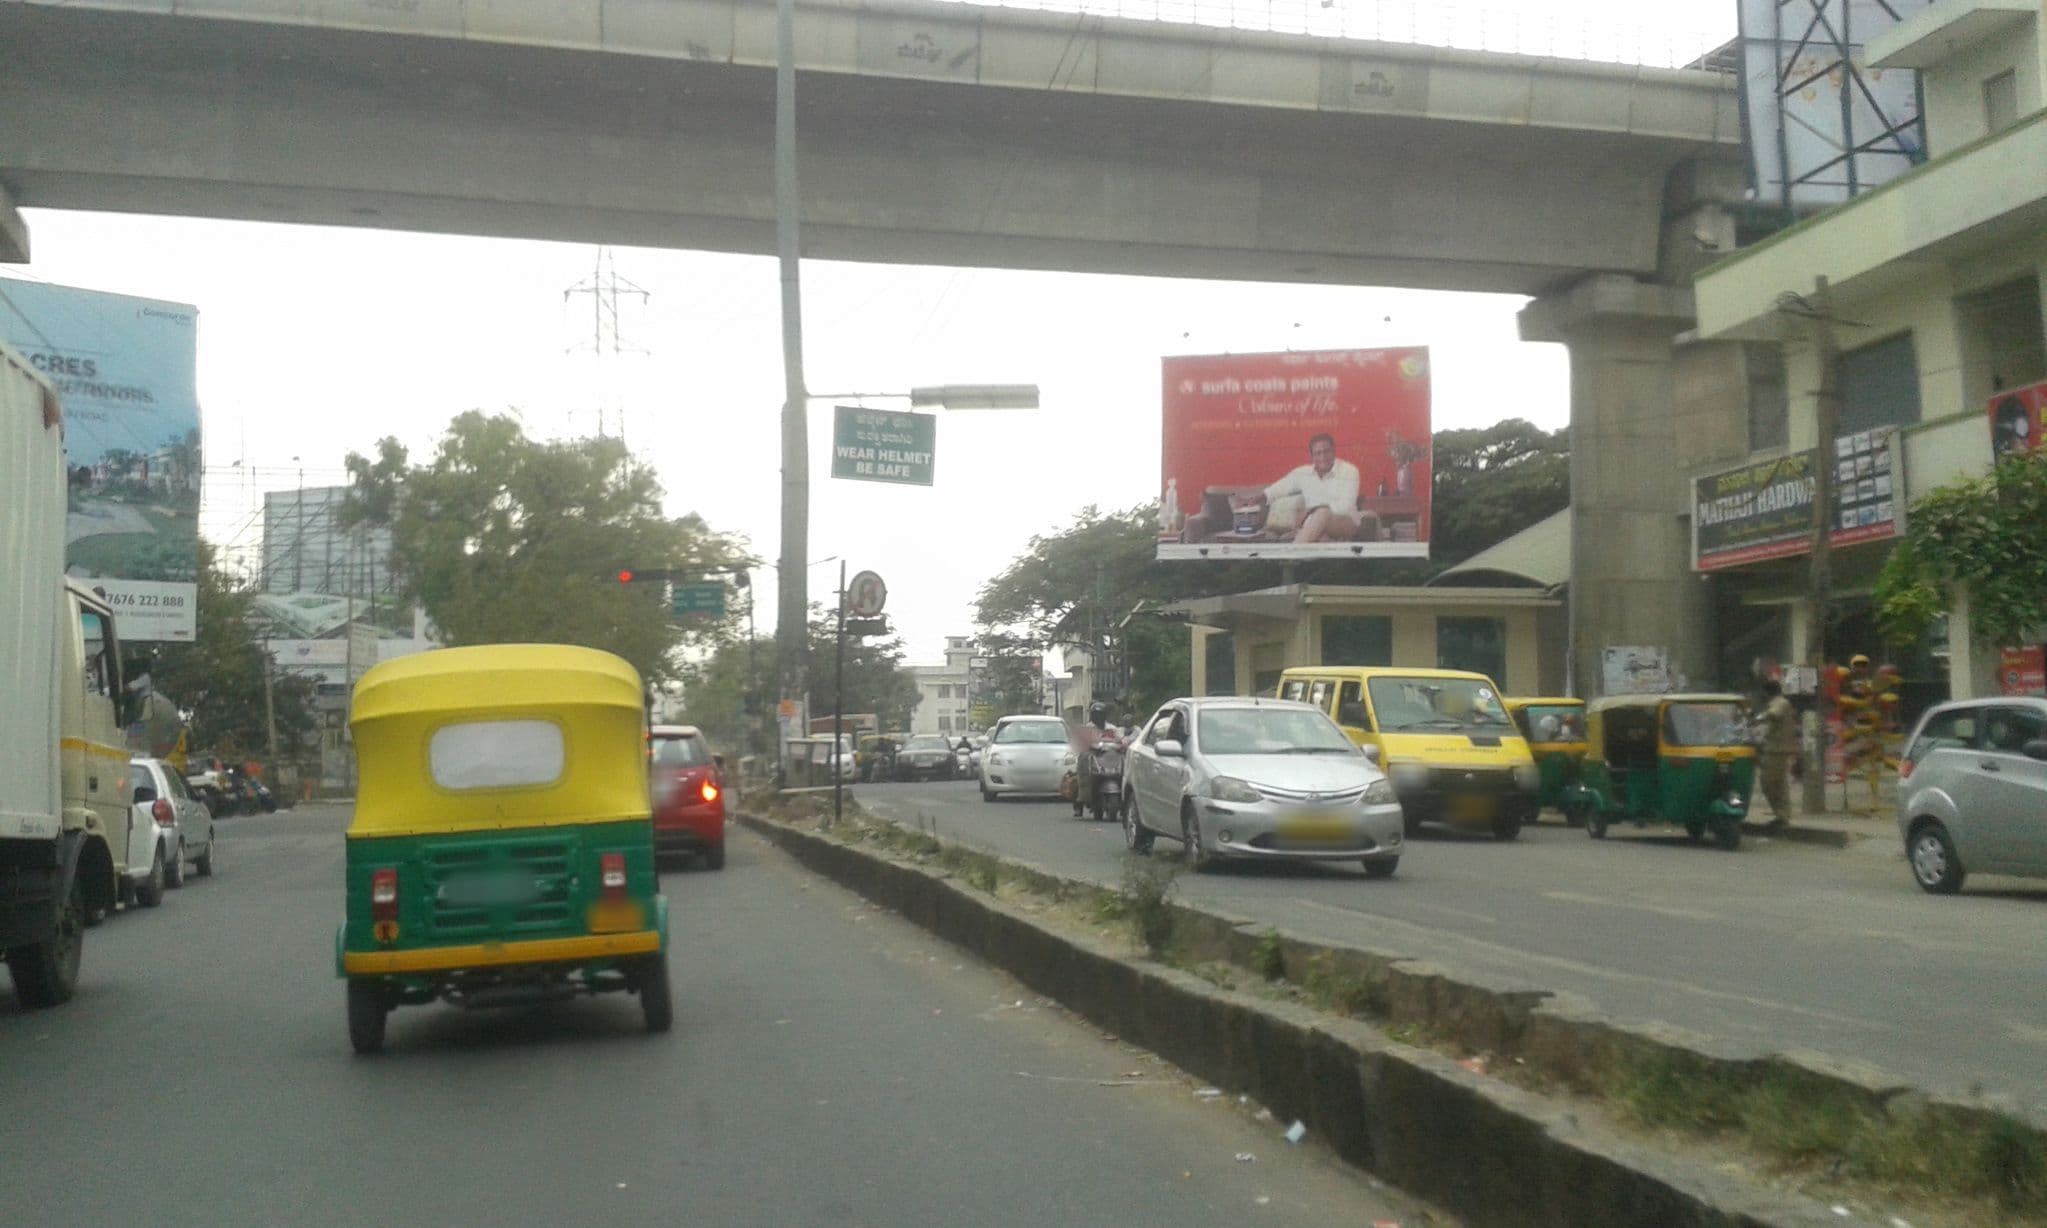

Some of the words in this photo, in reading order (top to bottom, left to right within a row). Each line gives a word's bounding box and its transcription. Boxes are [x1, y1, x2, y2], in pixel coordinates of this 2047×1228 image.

[836, 446, 875, 460] WEAR
[878, 448, 931, 465] HELMET
[856, 461, 874, 474] BE
[877, 463, 911, 478] SAFE
[139, 595, 158, 606] 222
